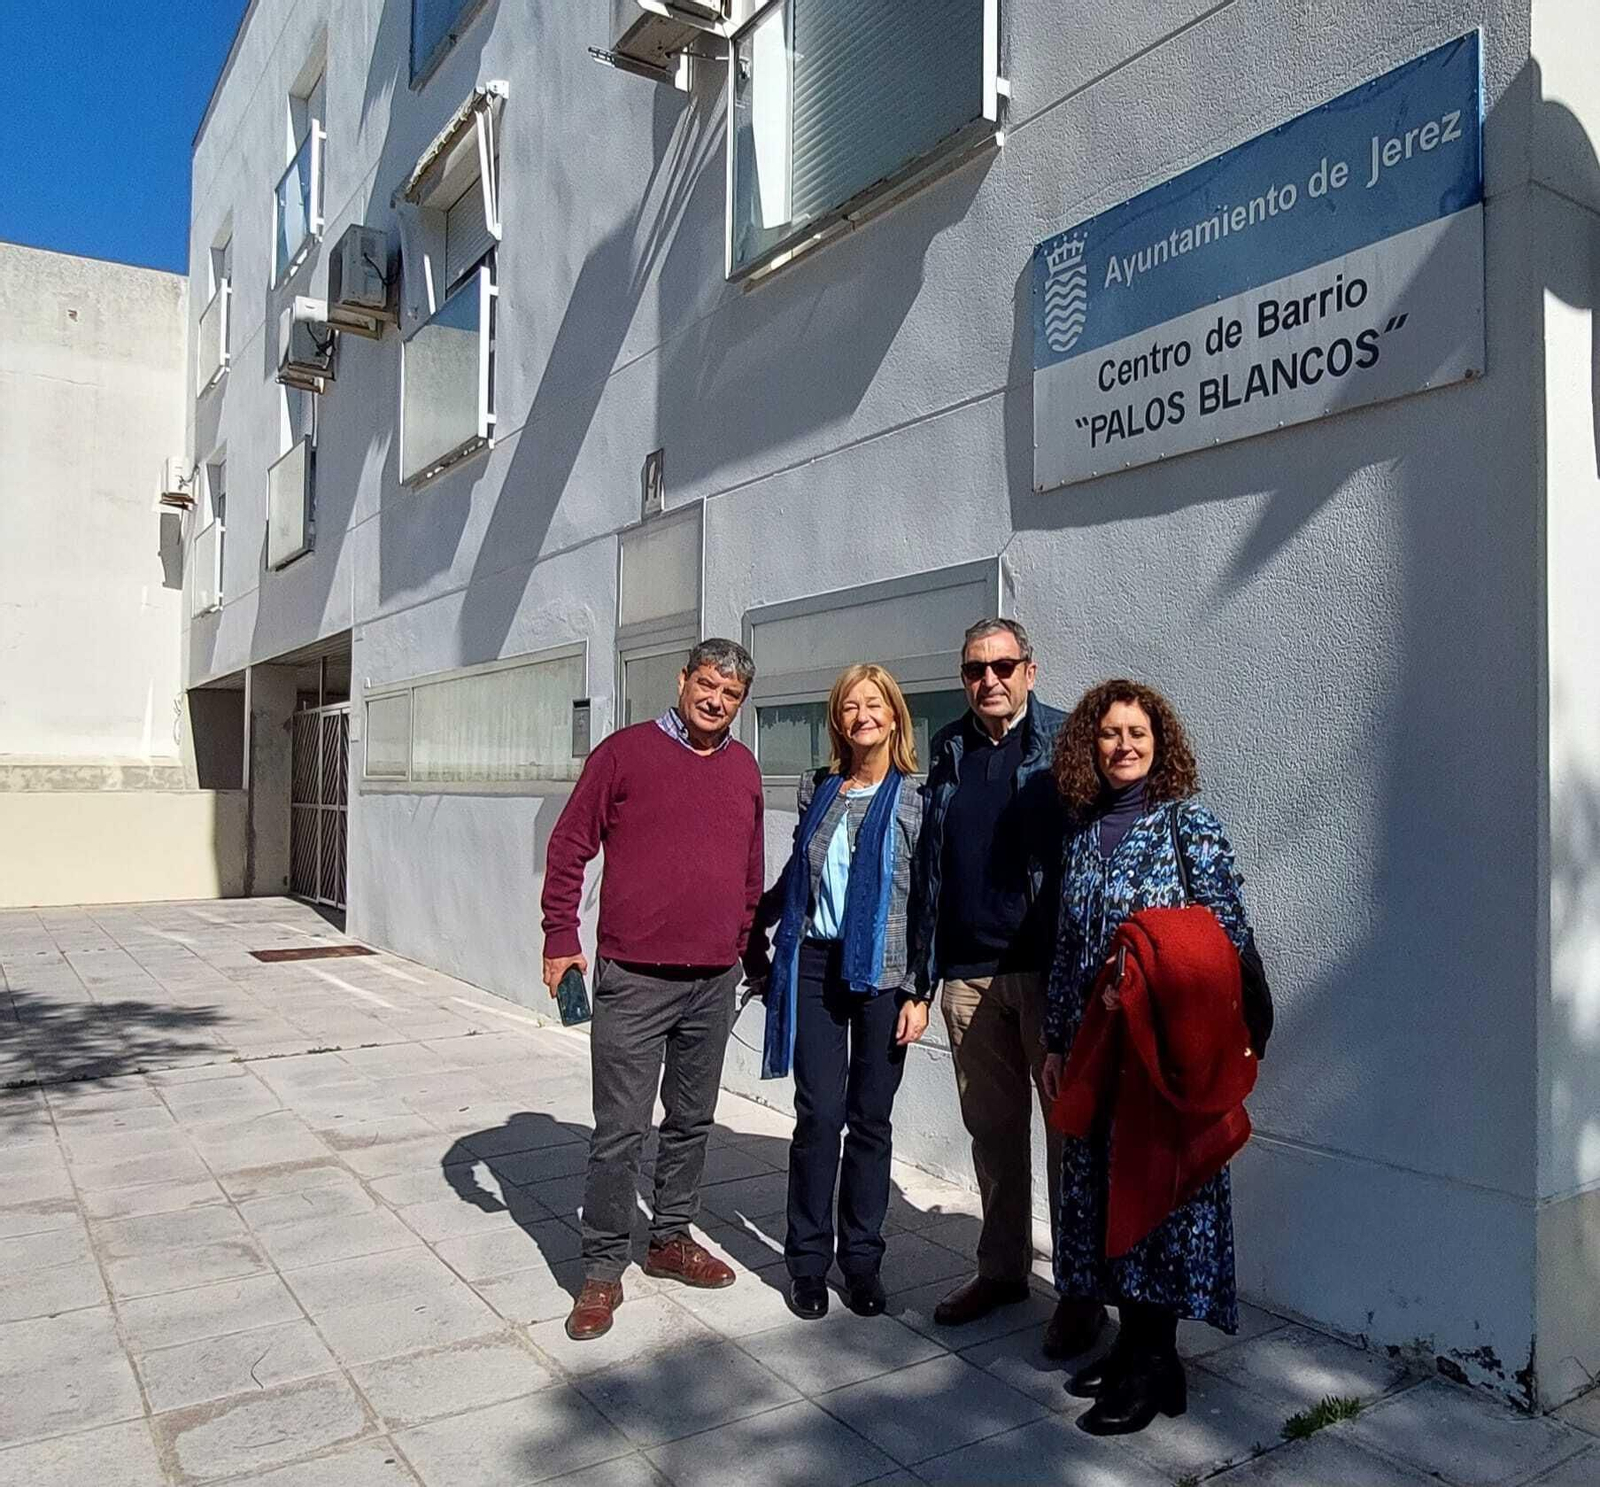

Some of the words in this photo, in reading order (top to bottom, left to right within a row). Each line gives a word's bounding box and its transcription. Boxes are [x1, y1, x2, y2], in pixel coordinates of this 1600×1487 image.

[1103, 184, 1297, 290] Ayuntamiento
[1309, 159, 1348, 199] de
[1365, 109, 1461, 188] Jerez
[1098, 340, 1191, 392] Centro
[1206, 318, 1242, 356] de
[1258, 274, 1368, 339] Barrio
